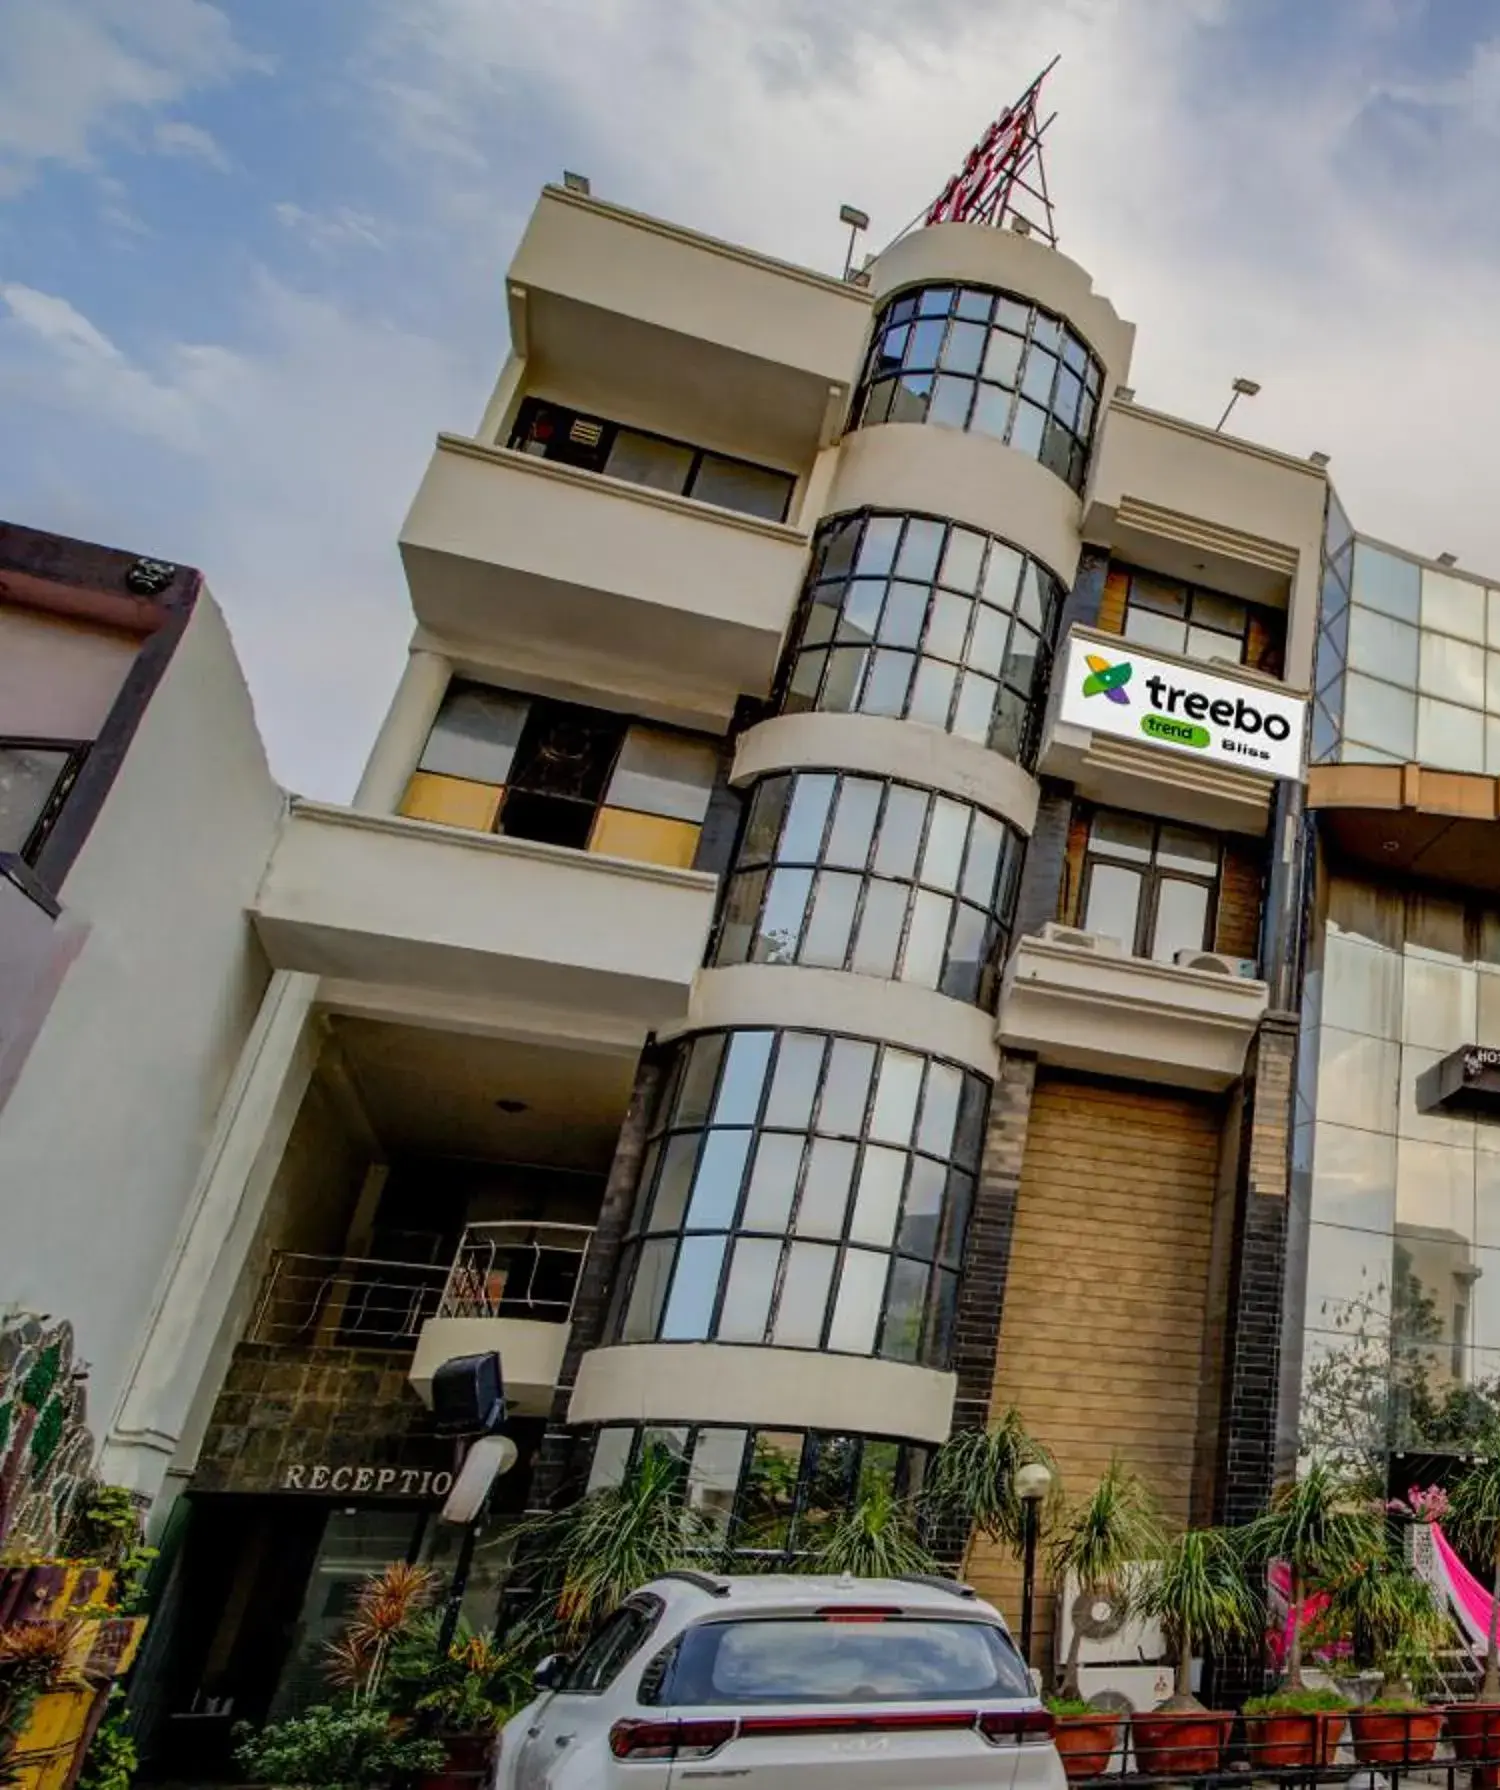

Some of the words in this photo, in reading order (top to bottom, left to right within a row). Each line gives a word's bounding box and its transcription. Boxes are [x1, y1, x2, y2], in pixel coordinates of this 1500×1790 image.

[1146, 675, 1290, 740] treebo
[1148, 717, 1193, 740] trend
[1221, 739, 1270, 760] Bliss
[283, 1463, 452, 1496] RECEPTIO
